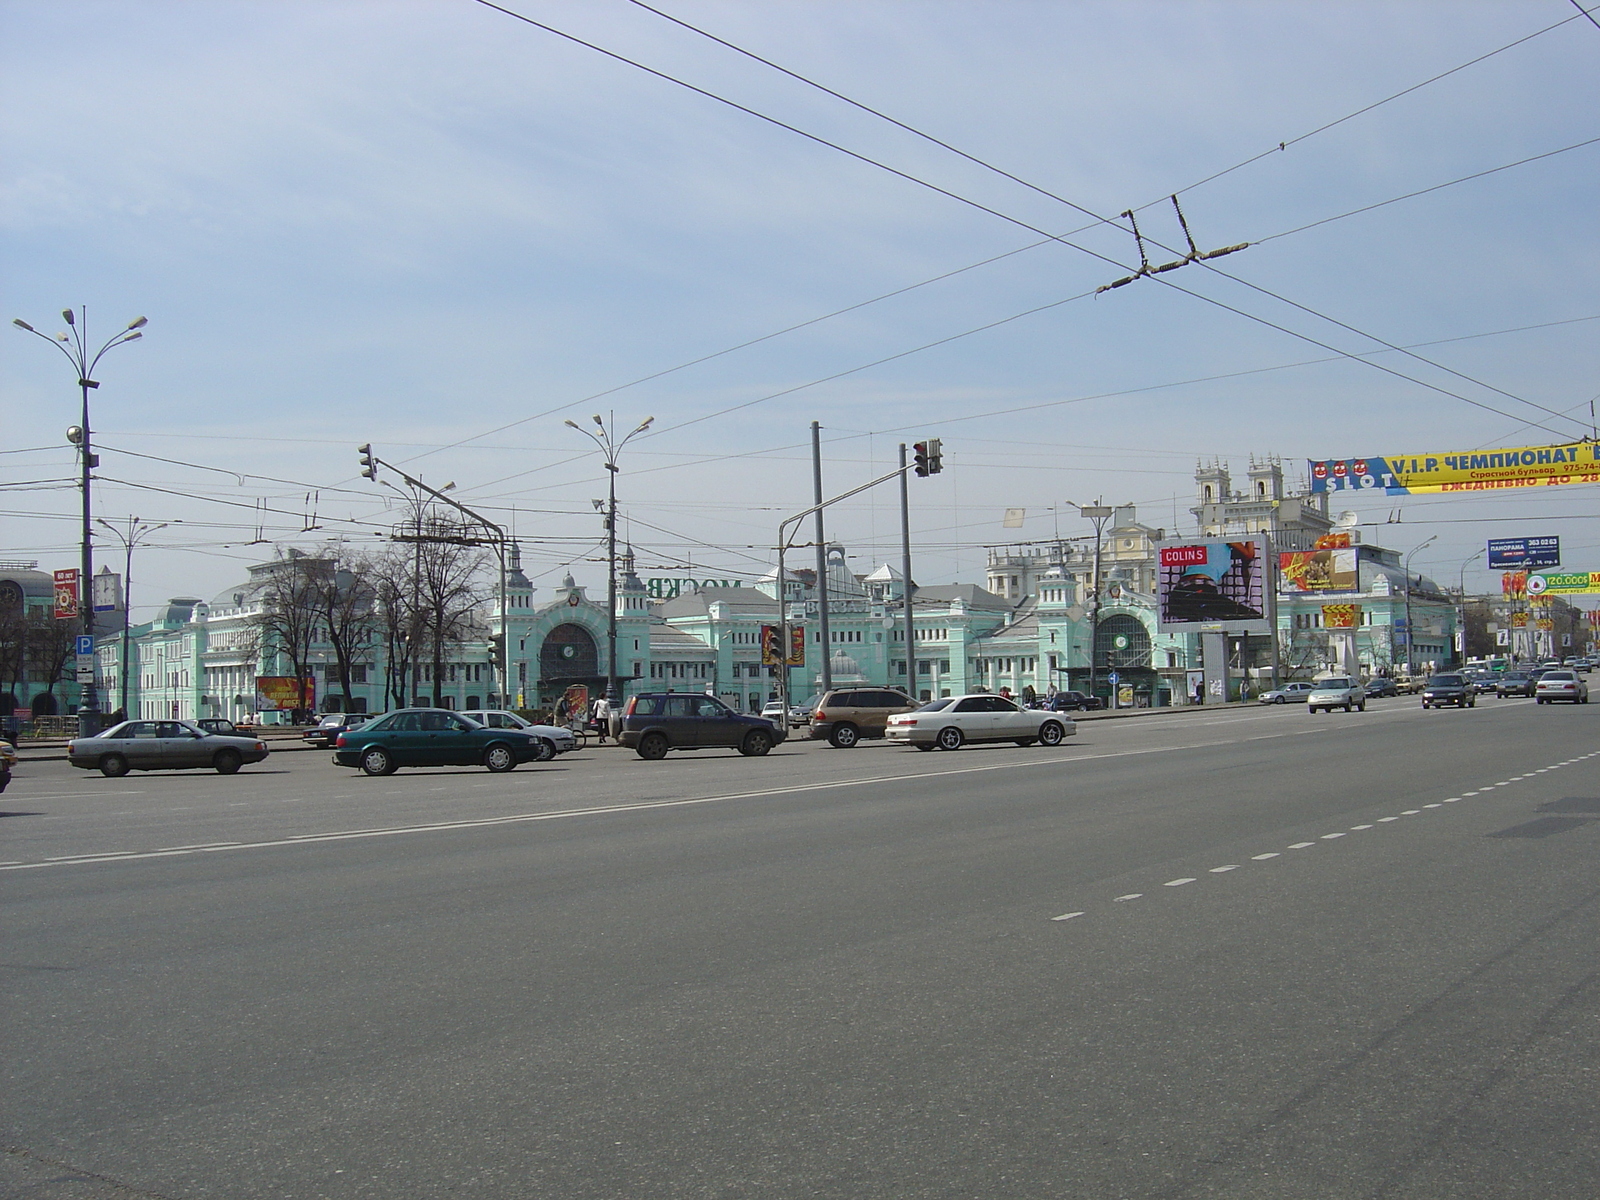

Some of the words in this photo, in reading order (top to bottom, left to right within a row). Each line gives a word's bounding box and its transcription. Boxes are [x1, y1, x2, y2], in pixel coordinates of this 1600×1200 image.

[1391, 458, 1439, 474] V.I.P.
[1445, 447, 1578, 470] ЧЕМПИОНАТ
[1470, 467, 1516, 479] Страстной
[1517, 466, 1556, 476] бульвар
[1326, 473, 1393, 493] SLOT
[1441, 476, 1538, 492] ЕЖЕДНЕВНО
[1547, 475, 1571, 486] ДО
[1581, 473, 1599, 482] 28
[81, 638, 91, 653] P
